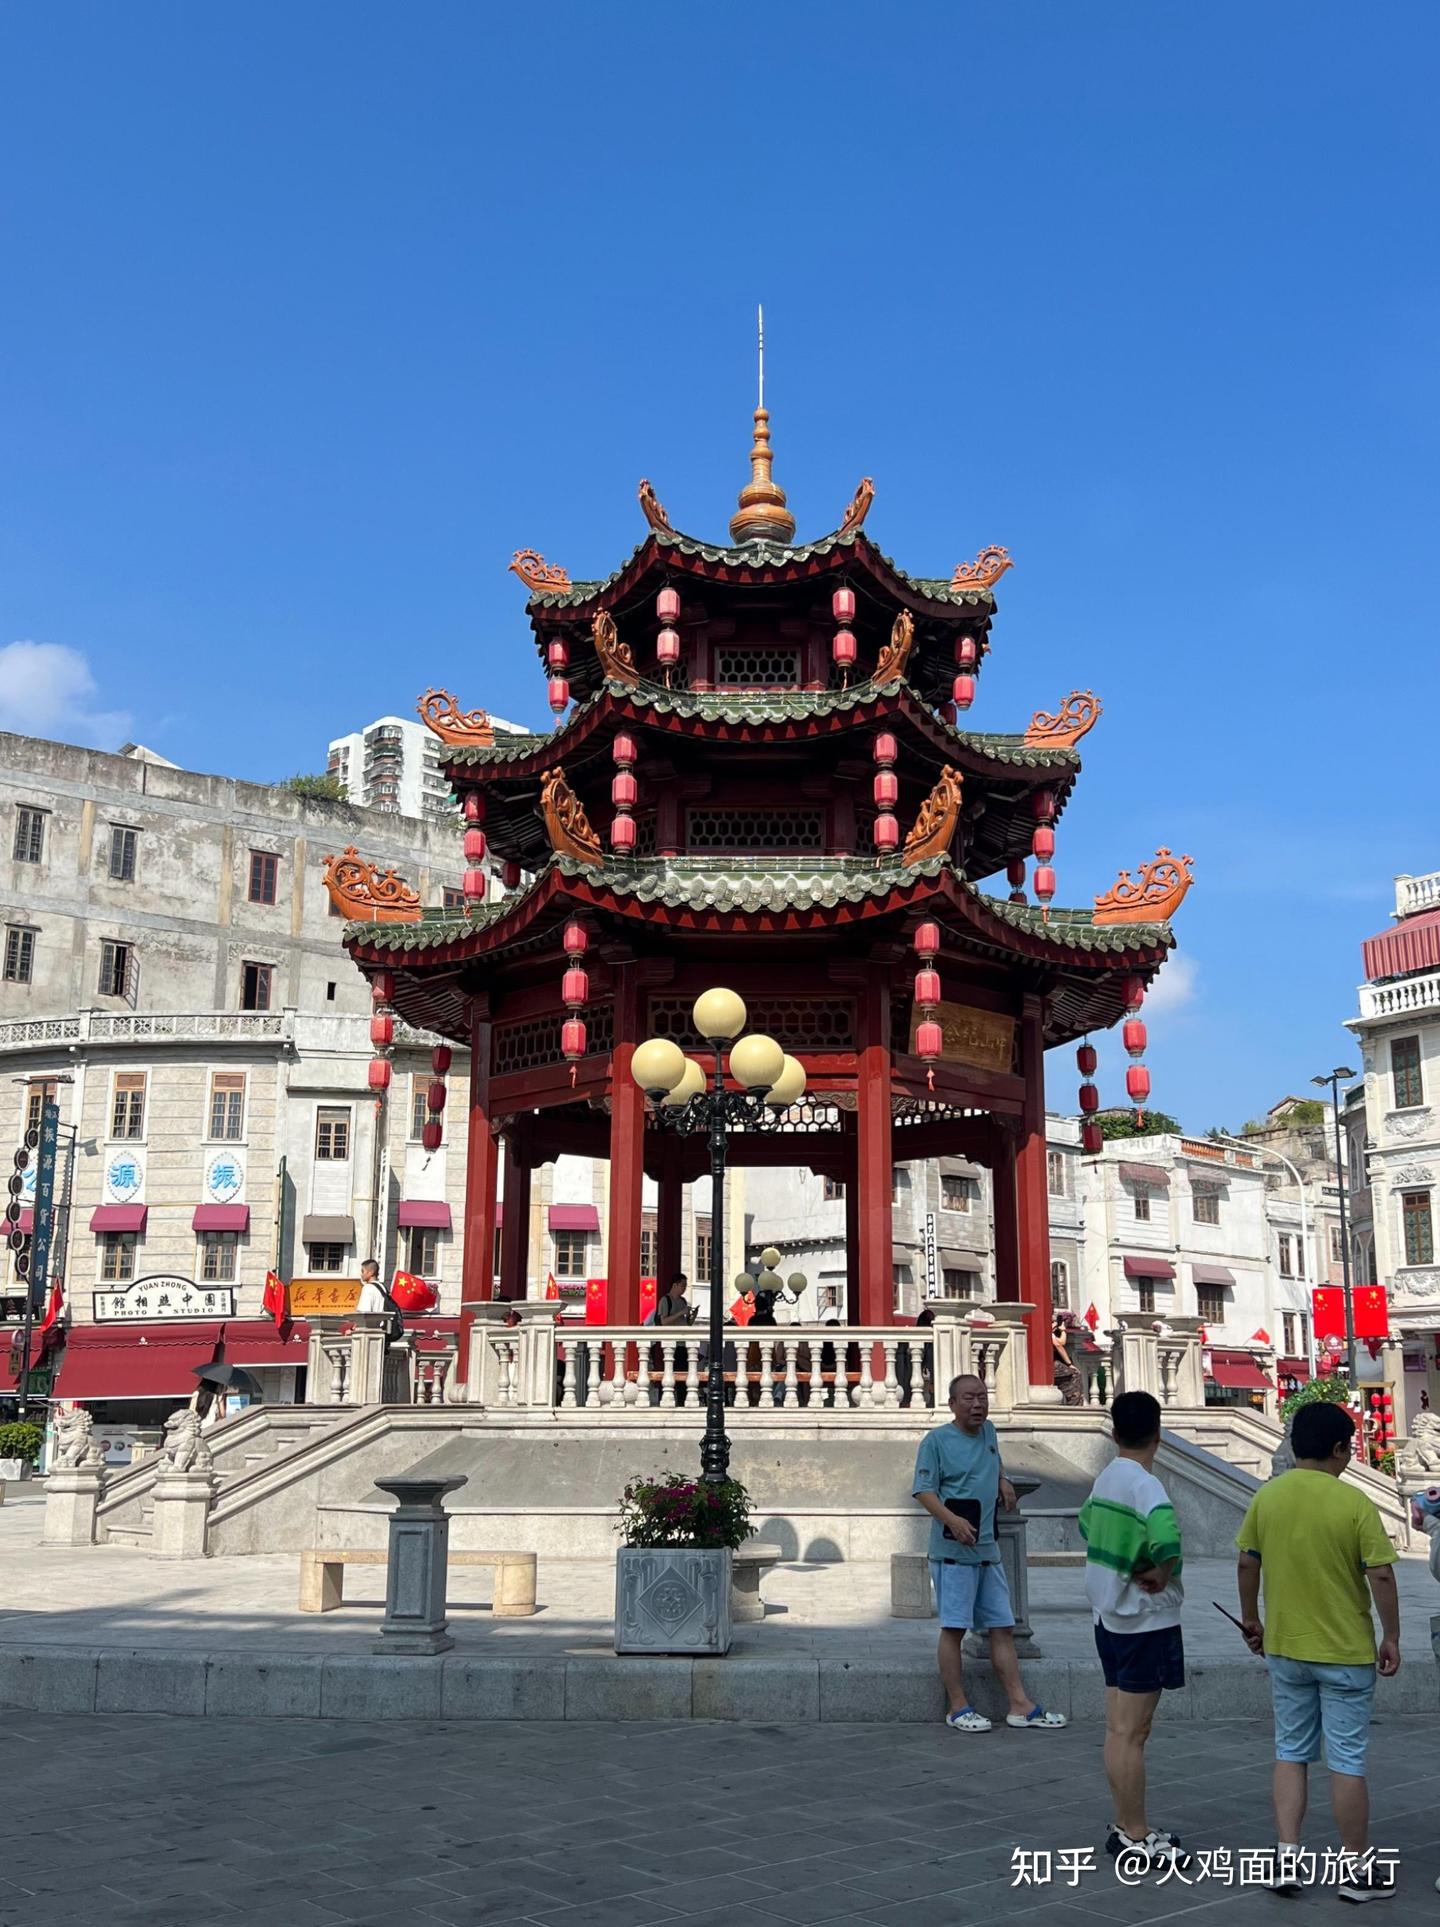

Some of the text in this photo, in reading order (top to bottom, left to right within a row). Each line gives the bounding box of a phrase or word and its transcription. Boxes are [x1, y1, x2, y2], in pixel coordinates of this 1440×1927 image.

[111, 1163, 137, 1189] 源
[211, 1163, 238, 1189] 振
[138, 1281, 187, 1292] YUAN ZHONG
